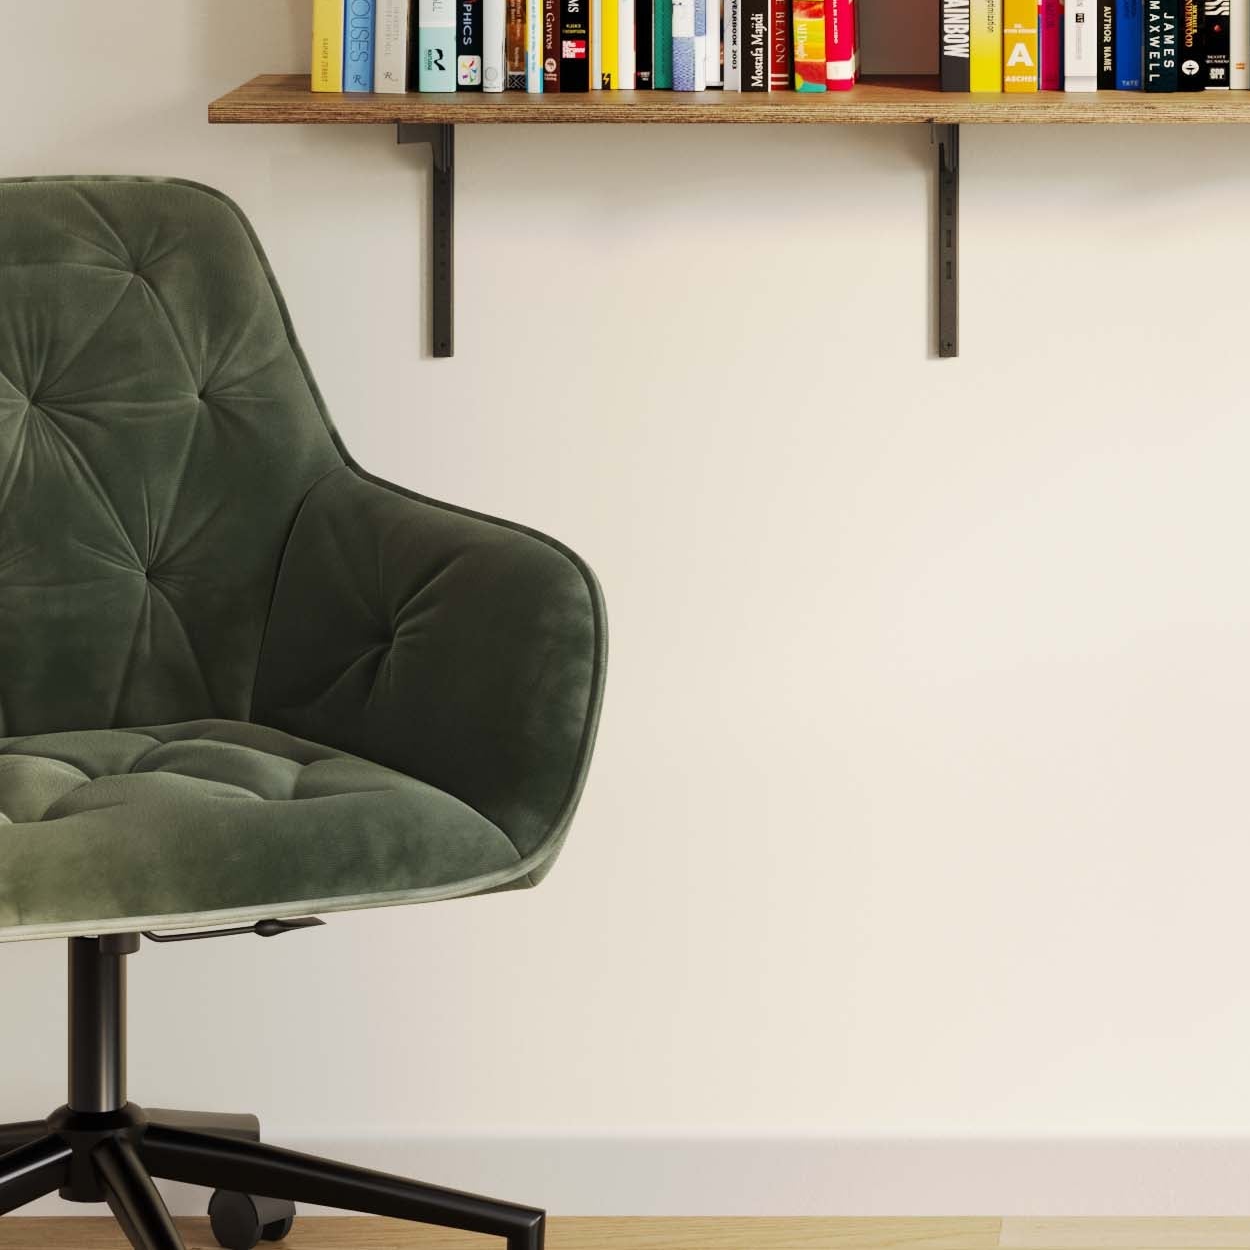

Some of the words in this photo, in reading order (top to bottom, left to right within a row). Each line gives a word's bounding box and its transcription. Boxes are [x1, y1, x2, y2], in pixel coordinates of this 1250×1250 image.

[545, 12, 555, 49] Gavros
[775, 11, 785, 63] BEATON
[1103, 6, 1112, 43] AUTHOR
[1149, 0, 1160, 82] MAXWELL
[1163, 12, 1174, 68] JAMES
[1103, 46, 1111, 71] NAME
